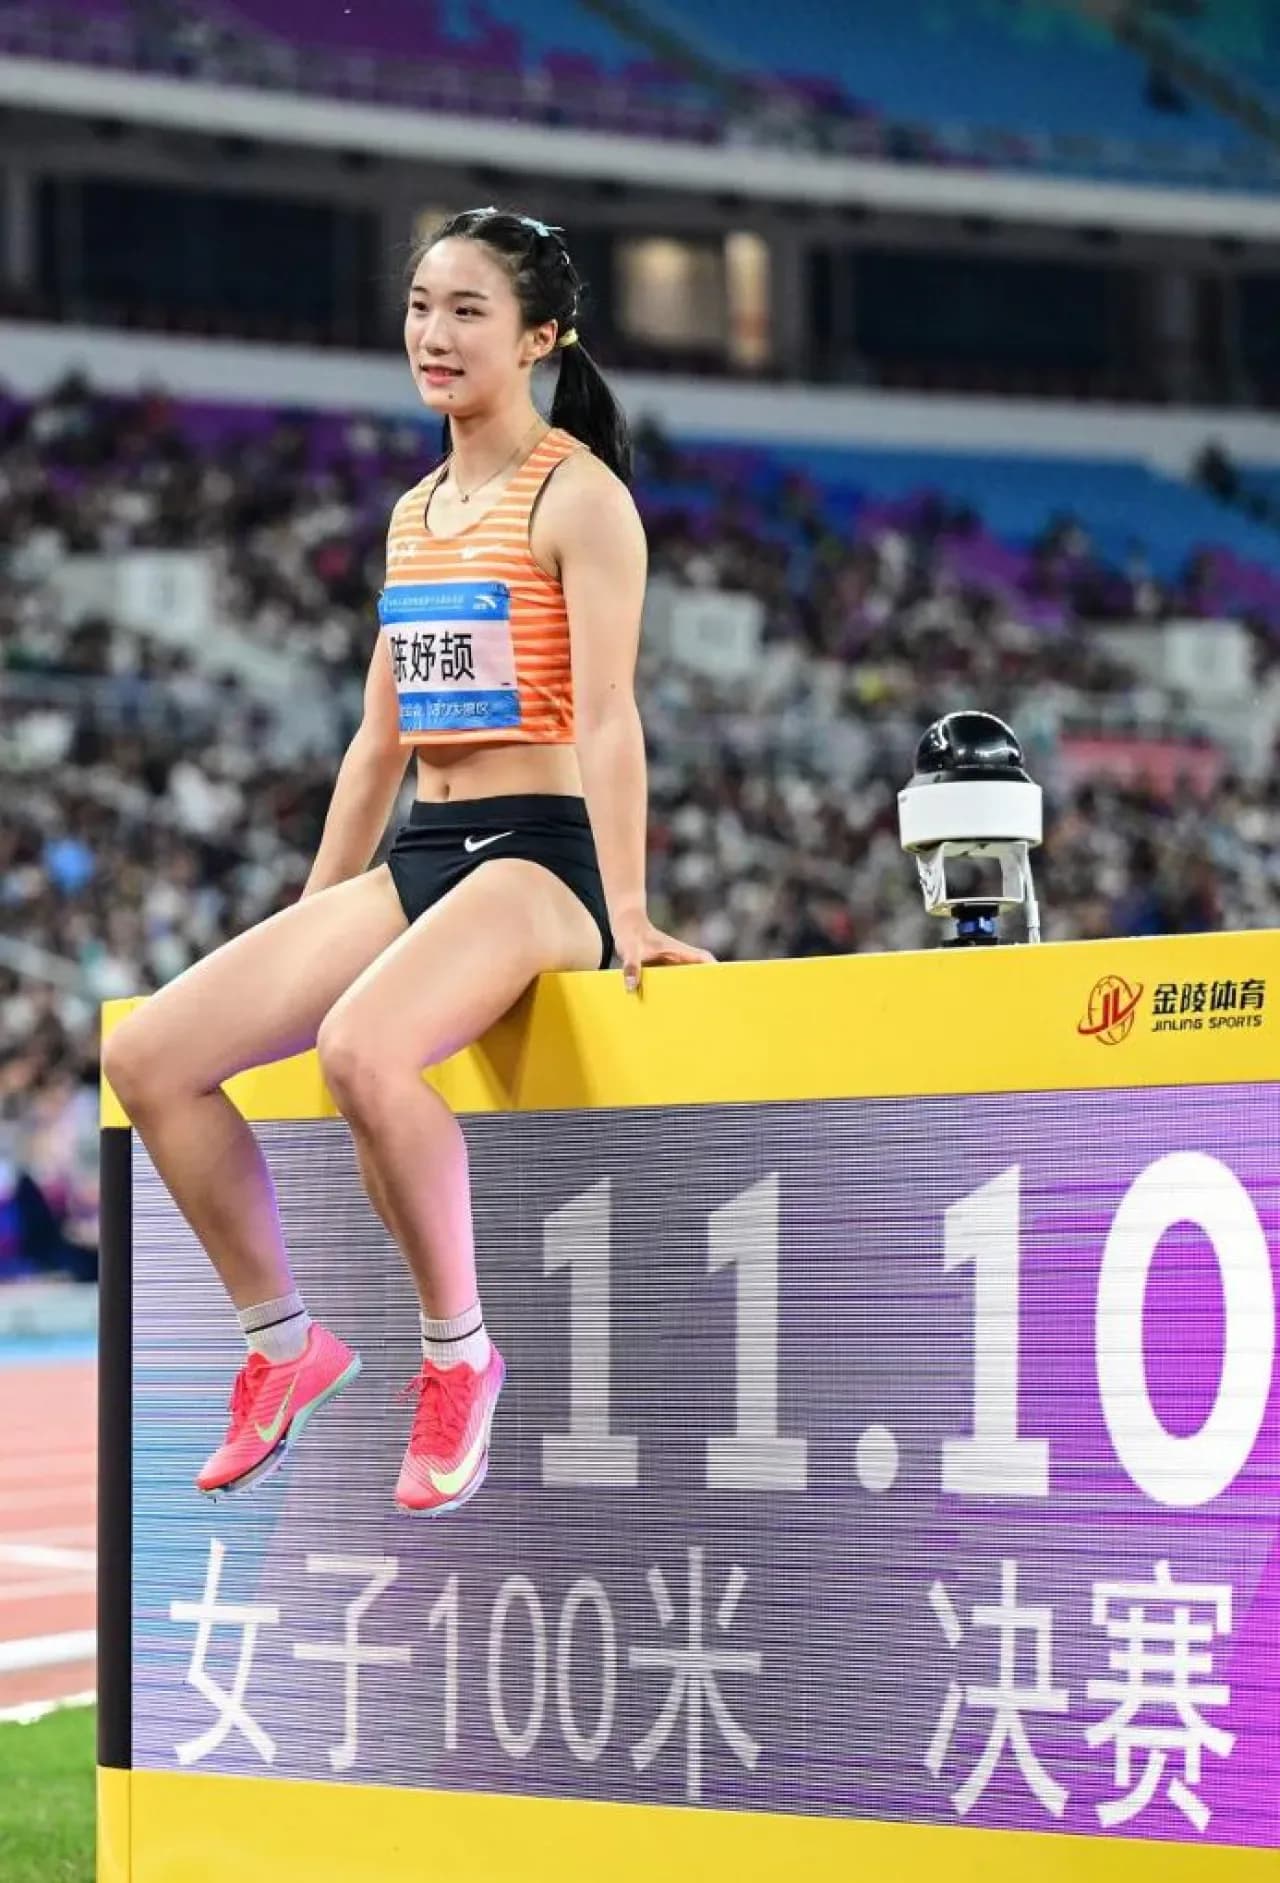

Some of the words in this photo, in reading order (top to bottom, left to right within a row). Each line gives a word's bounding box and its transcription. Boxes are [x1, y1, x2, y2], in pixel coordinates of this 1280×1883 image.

[1151, 1018, 1203, 1032] JINLING
[1208, 1014, 1262, 1029] SPORTS
[1152, 978, 1266, 1015] 金陵体育
[542, 1151, 1276, 1506] 11.10
[170, 1537, 762, 1798] 女子100米
[924, 1559, 1237, 1832] 决赛
